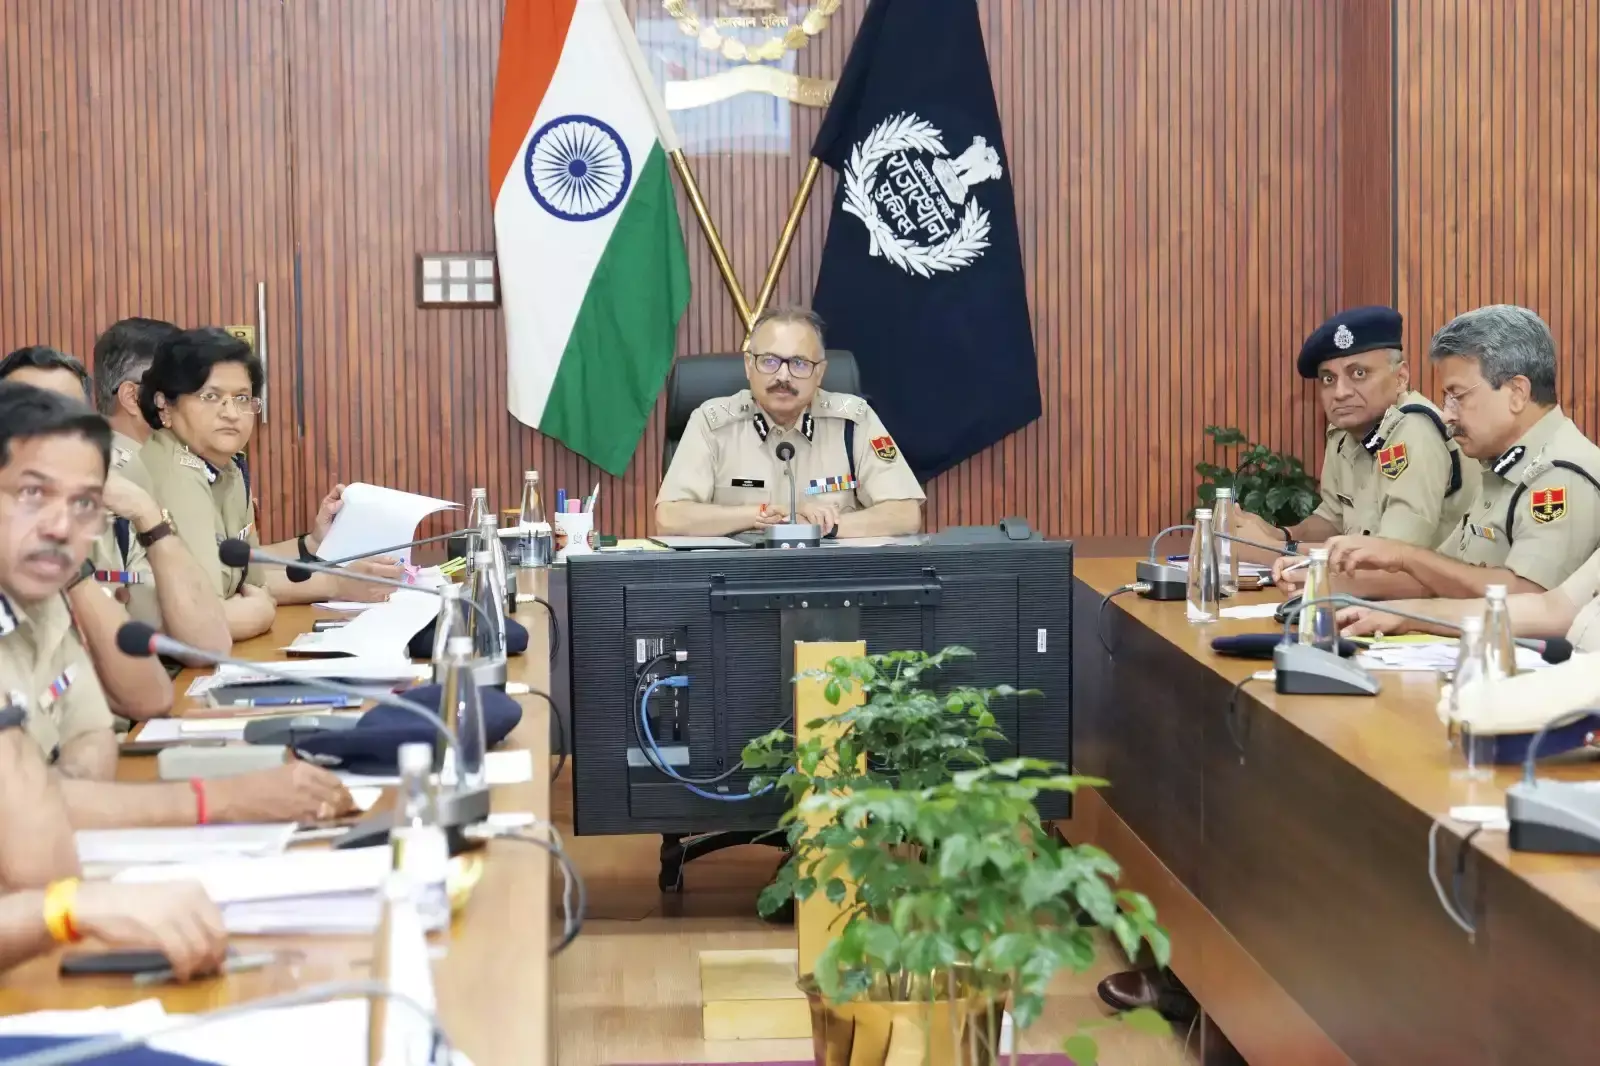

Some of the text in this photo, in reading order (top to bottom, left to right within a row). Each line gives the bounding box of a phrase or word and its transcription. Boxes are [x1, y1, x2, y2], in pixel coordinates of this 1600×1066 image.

[760, 13, 789, 29] पुलिस
[875, 179, 917, 236] पुलिस
[886, 151, 950, 242] राजस्थान
